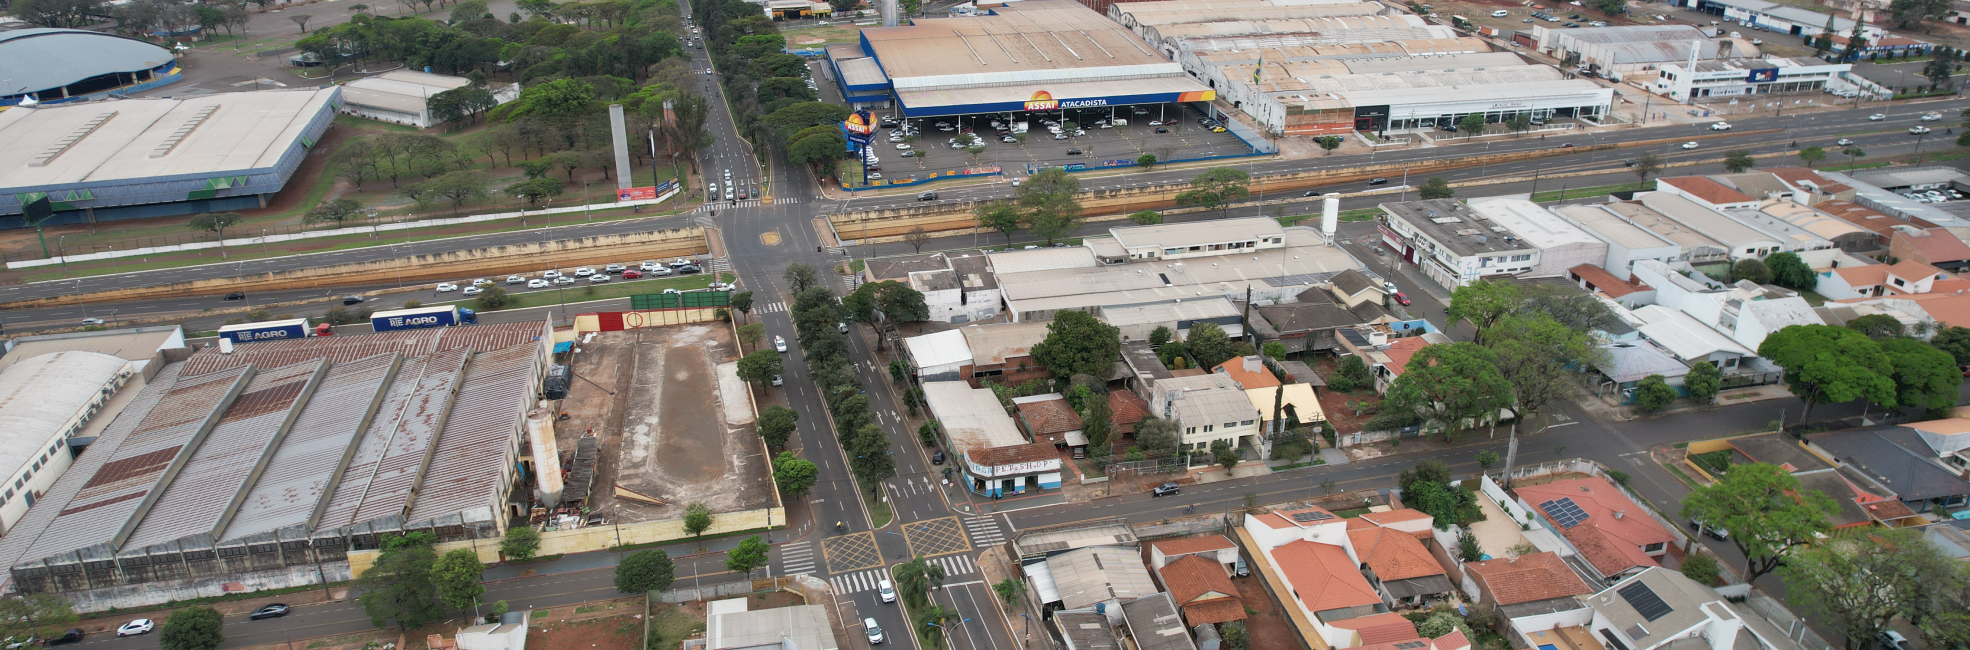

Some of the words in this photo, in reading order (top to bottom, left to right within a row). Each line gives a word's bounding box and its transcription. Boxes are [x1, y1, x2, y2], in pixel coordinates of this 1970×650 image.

[1061, 99, 1107, 108] ATACADISTA
[388, 317, 404, 327] RTE
[405, 316, 438, 326] AGRO
[236, 331, 252, 341] RTE
[254, 330, 287, 340] AGRO
[996, 465, 1014, 473] PET
[1019, 460, 1049, 470] SHOP
